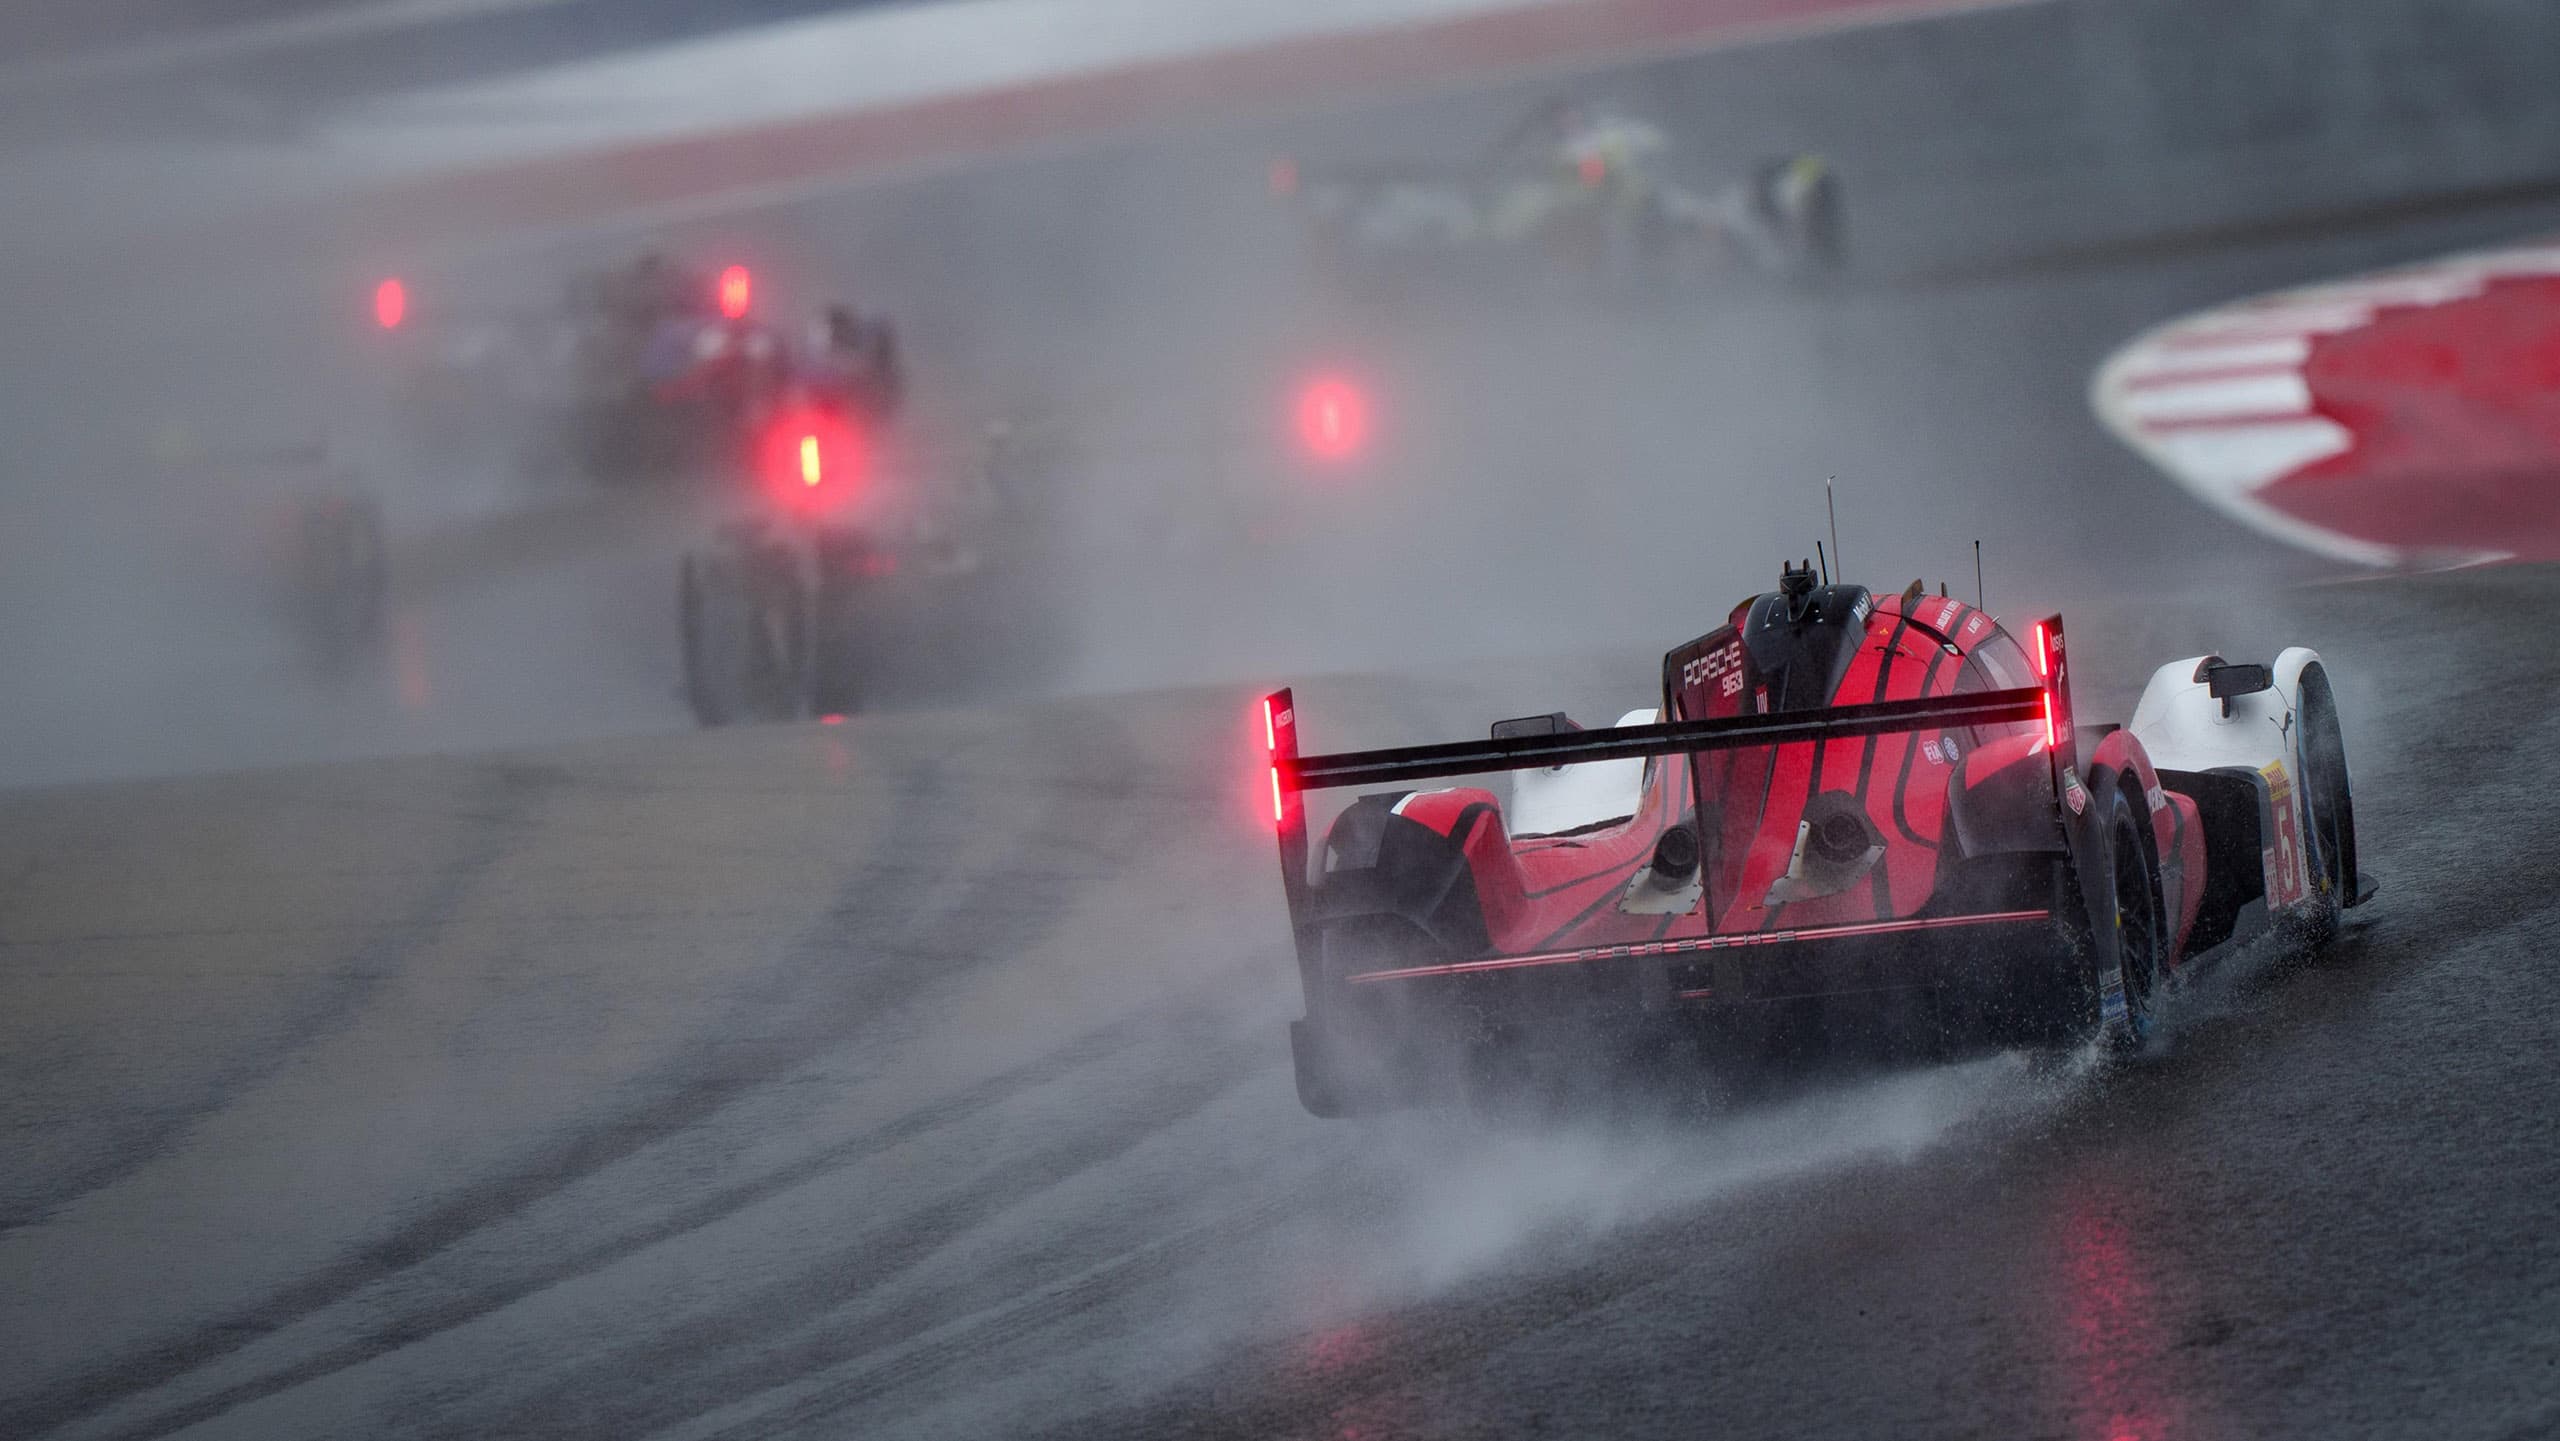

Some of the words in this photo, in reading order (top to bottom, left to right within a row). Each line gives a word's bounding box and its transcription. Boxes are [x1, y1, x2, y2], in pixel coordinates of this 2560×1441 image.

[1684, 641, 1741, 690] PORSCHE
[1722, 670, 1743, 697] 963
[1924, 742, 1944, 763] FIA
[1578, 930, 1796, 960] PORSCHE
